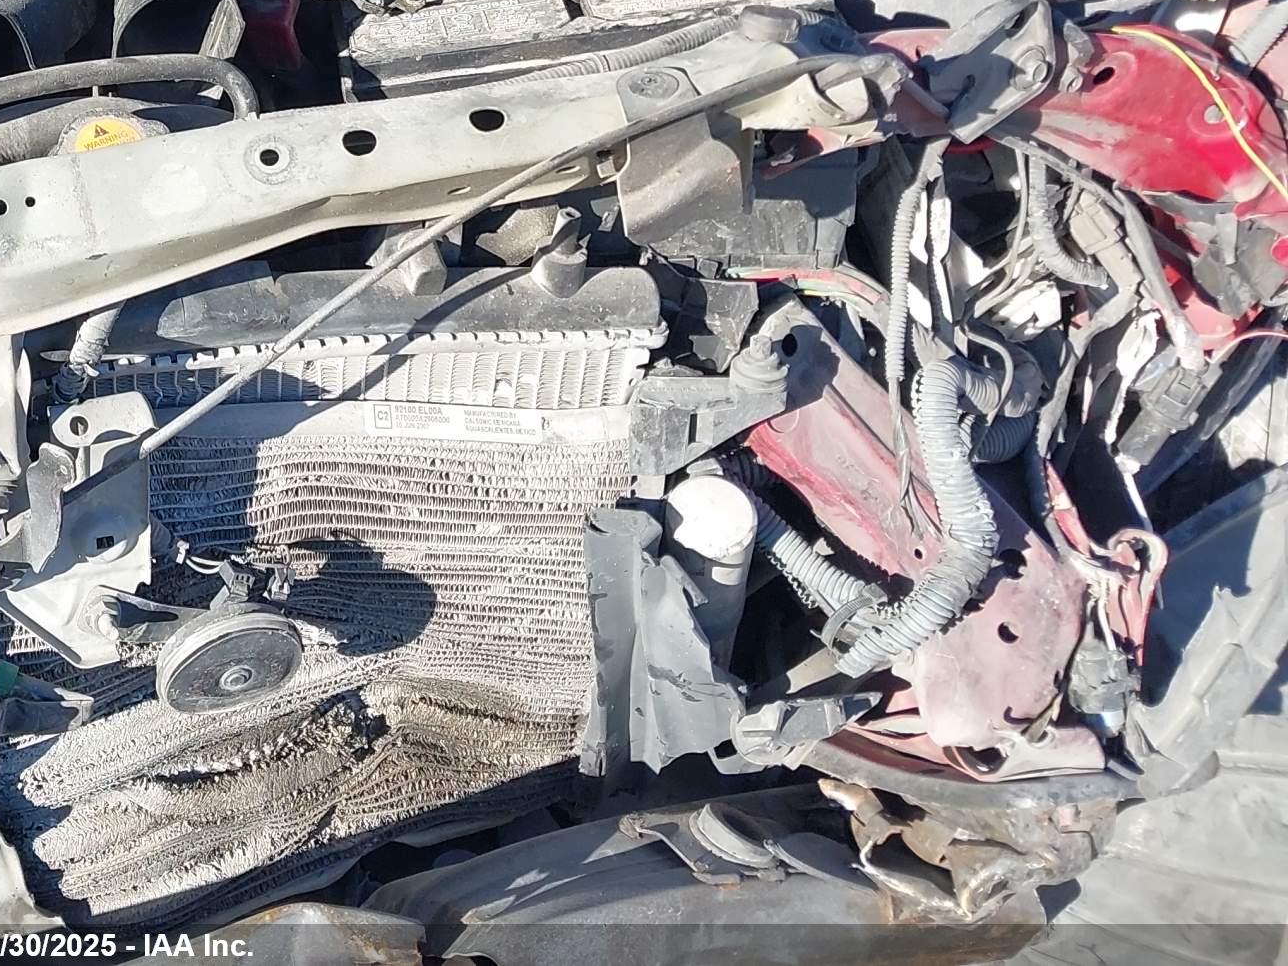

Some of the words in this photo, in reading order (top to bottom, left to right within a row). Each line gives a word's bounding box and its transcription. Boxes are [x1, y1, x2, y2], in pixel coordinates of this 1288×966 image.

[84, 130, 128, 151] WARNING
[377, 410, 389, 421] C2
[464, 409, 508, 419] MANUFACTURED
